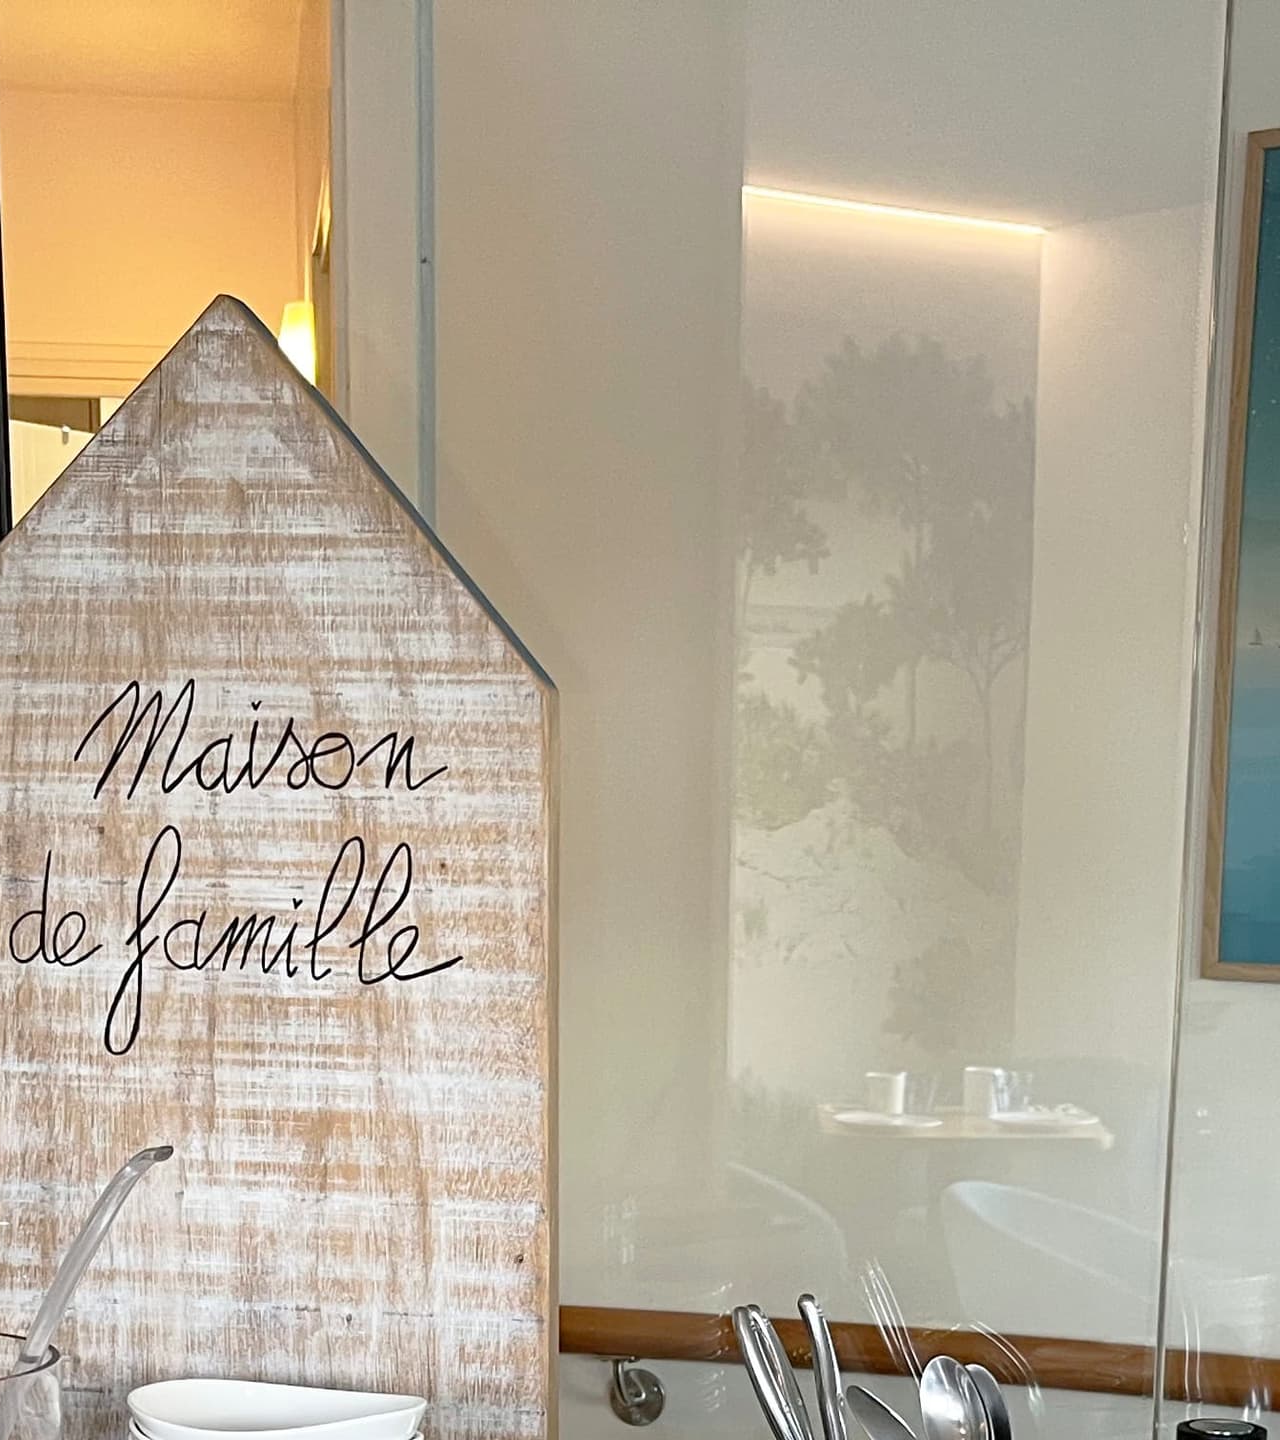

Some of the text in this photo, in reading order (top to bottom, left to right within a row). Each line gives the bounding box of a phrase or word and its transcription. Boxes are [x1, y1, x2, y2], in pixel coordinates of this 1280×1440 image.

[74, 679, 447, 799] Maison
[10, 825, 464, 1055] de famille
